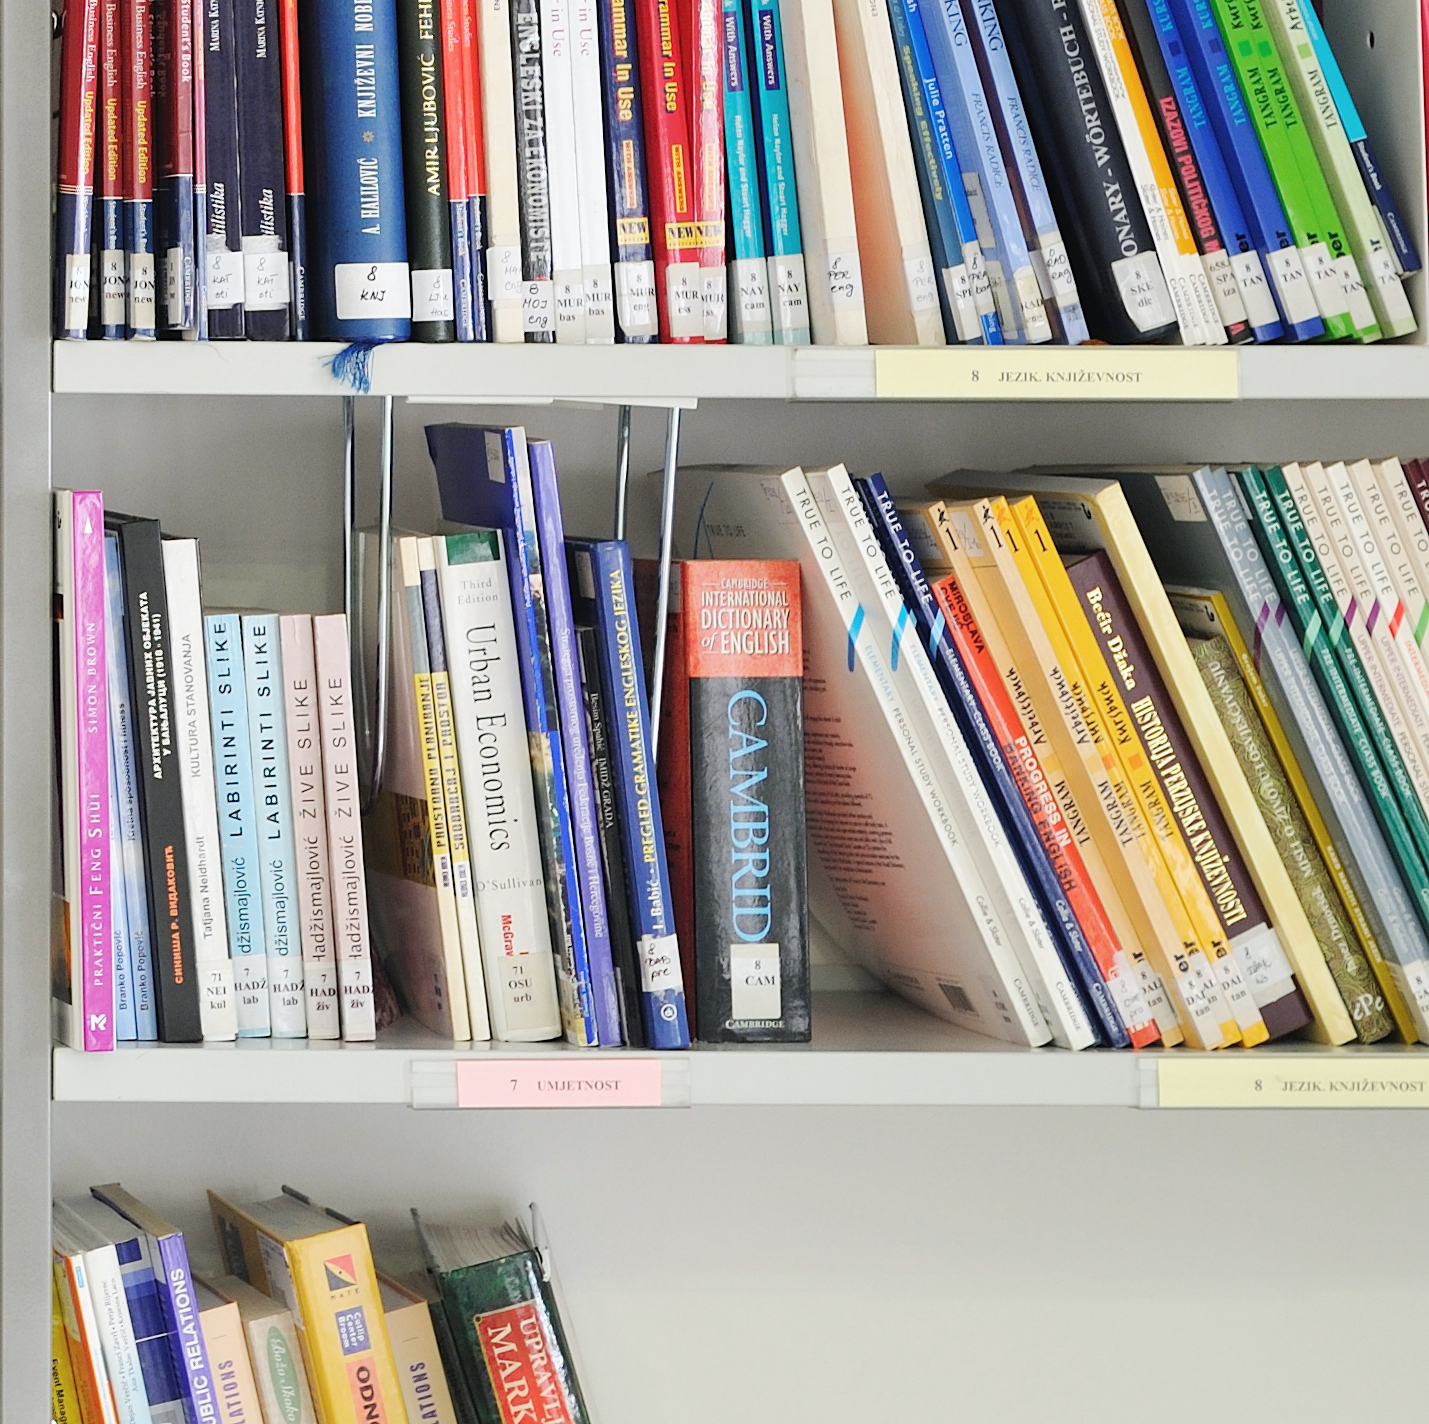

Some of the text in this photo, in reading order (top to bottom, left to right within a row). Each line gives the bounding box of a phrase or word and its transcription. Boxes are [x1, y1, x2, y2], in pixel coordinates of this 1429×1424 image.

[351, 44, 378, 118] KNJIŽEVNI
[972, 370, 979, 382] 8
[1046, 369, 1143, 383] KNJIŽEVNOST
[794, 487, 852, 600] TRUE TO LIFE
[699, 608, 791, 628] DICTIONARY
[252, 625, 282, 841] LABIRINTI SLIKE
[464, 624, 517, 852] Urban Economics
[510, 1080, 621, 1091] 7 UMJETNOST
[1255, 1080, 1262, 1091] 8
[1329, 1079, 1426, 1092] KNJIŽEVNOST
[168, 1268, 207, 1370] RELATIONS
